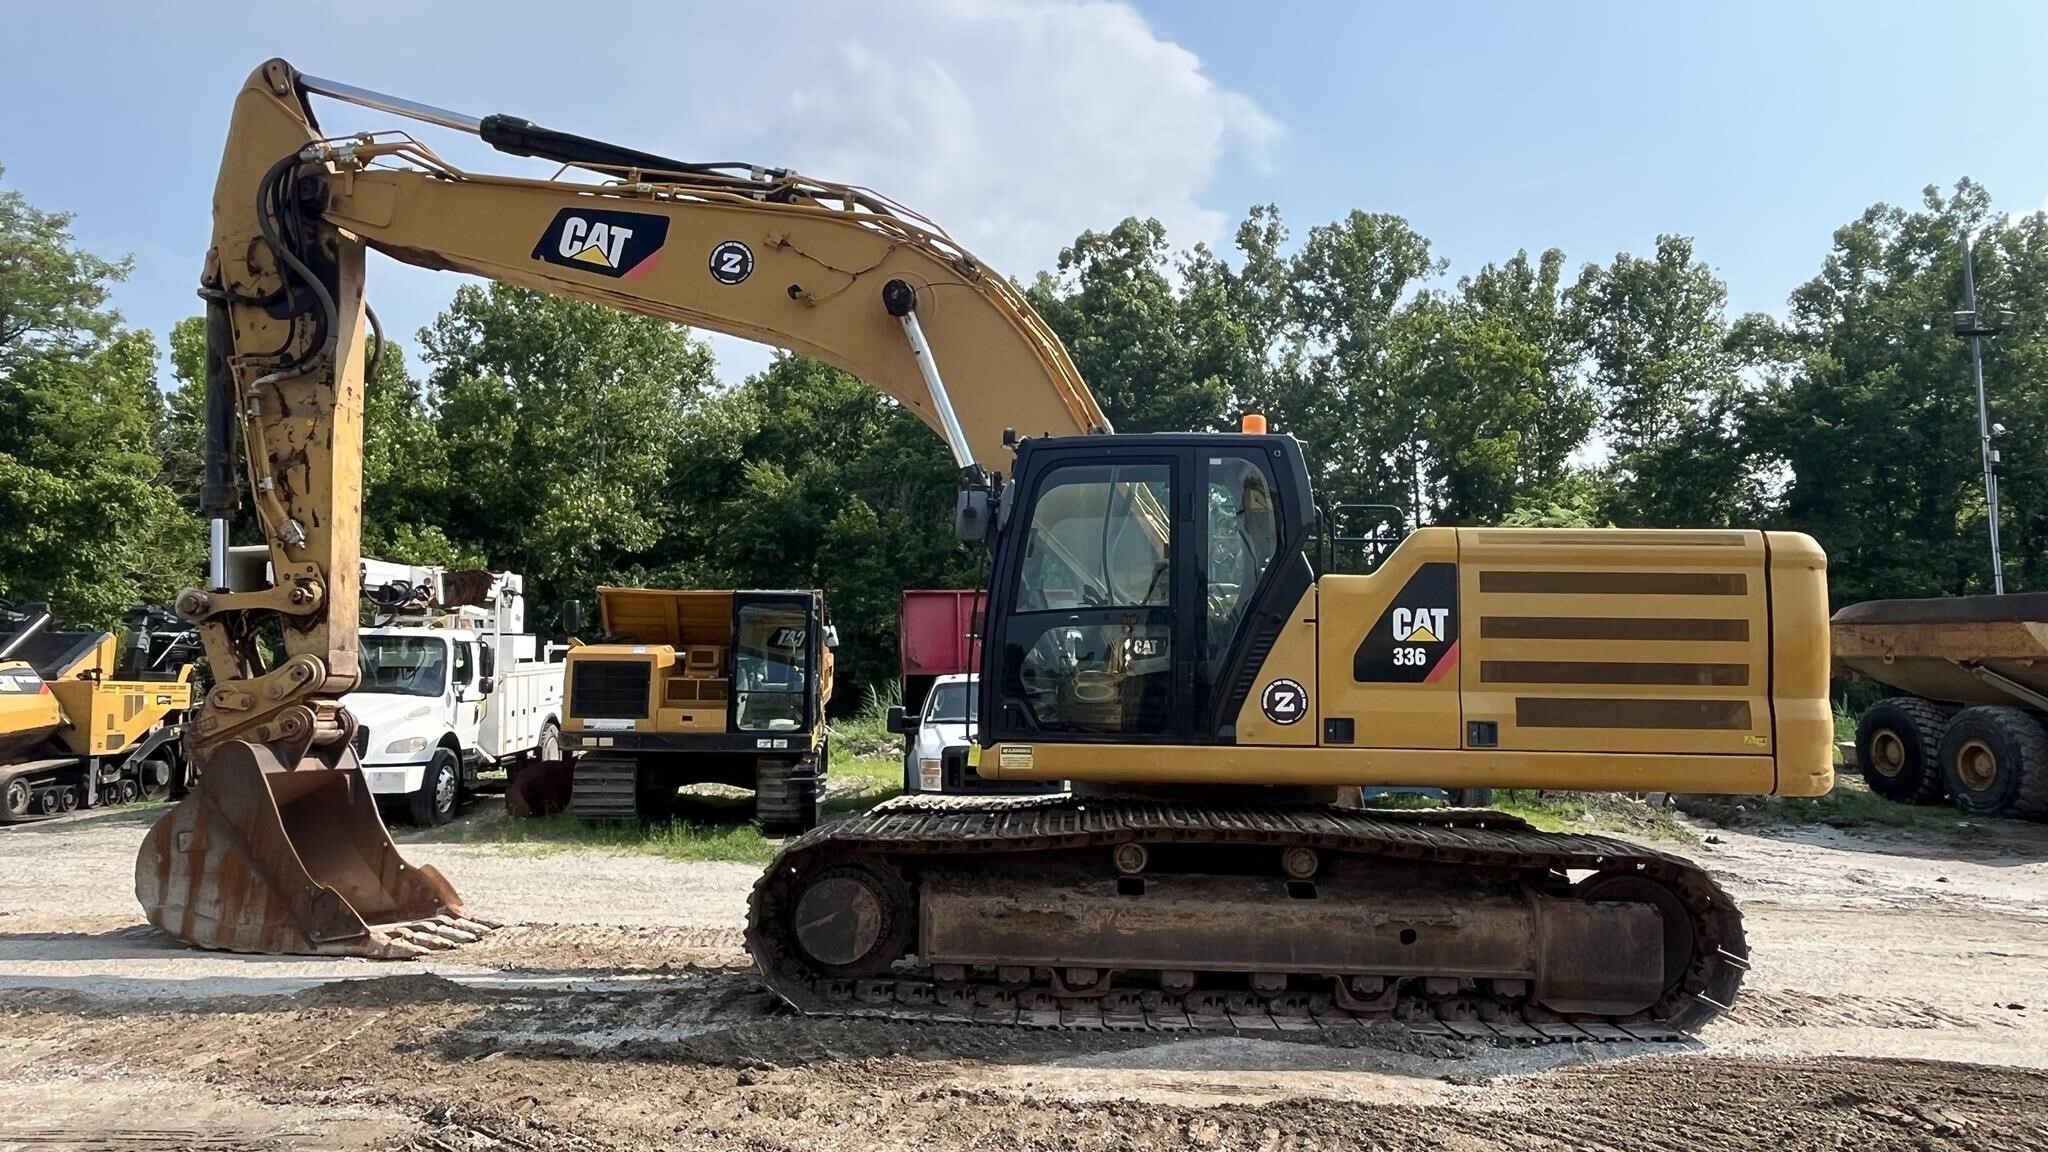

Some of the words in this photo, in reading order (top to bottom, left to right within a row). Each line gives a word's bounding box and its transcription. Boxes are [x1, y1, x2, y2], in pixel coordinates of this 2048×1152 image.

[558, 216, 633, 269] CAT
[720, 252, 743, 274] Z
[1392, 607, 1449, 642] CAT
[1133, 640, 1159, 655] CAT
[1392, 647, 1427, 666] 336
[1274, 691, 1295, 712] Z
